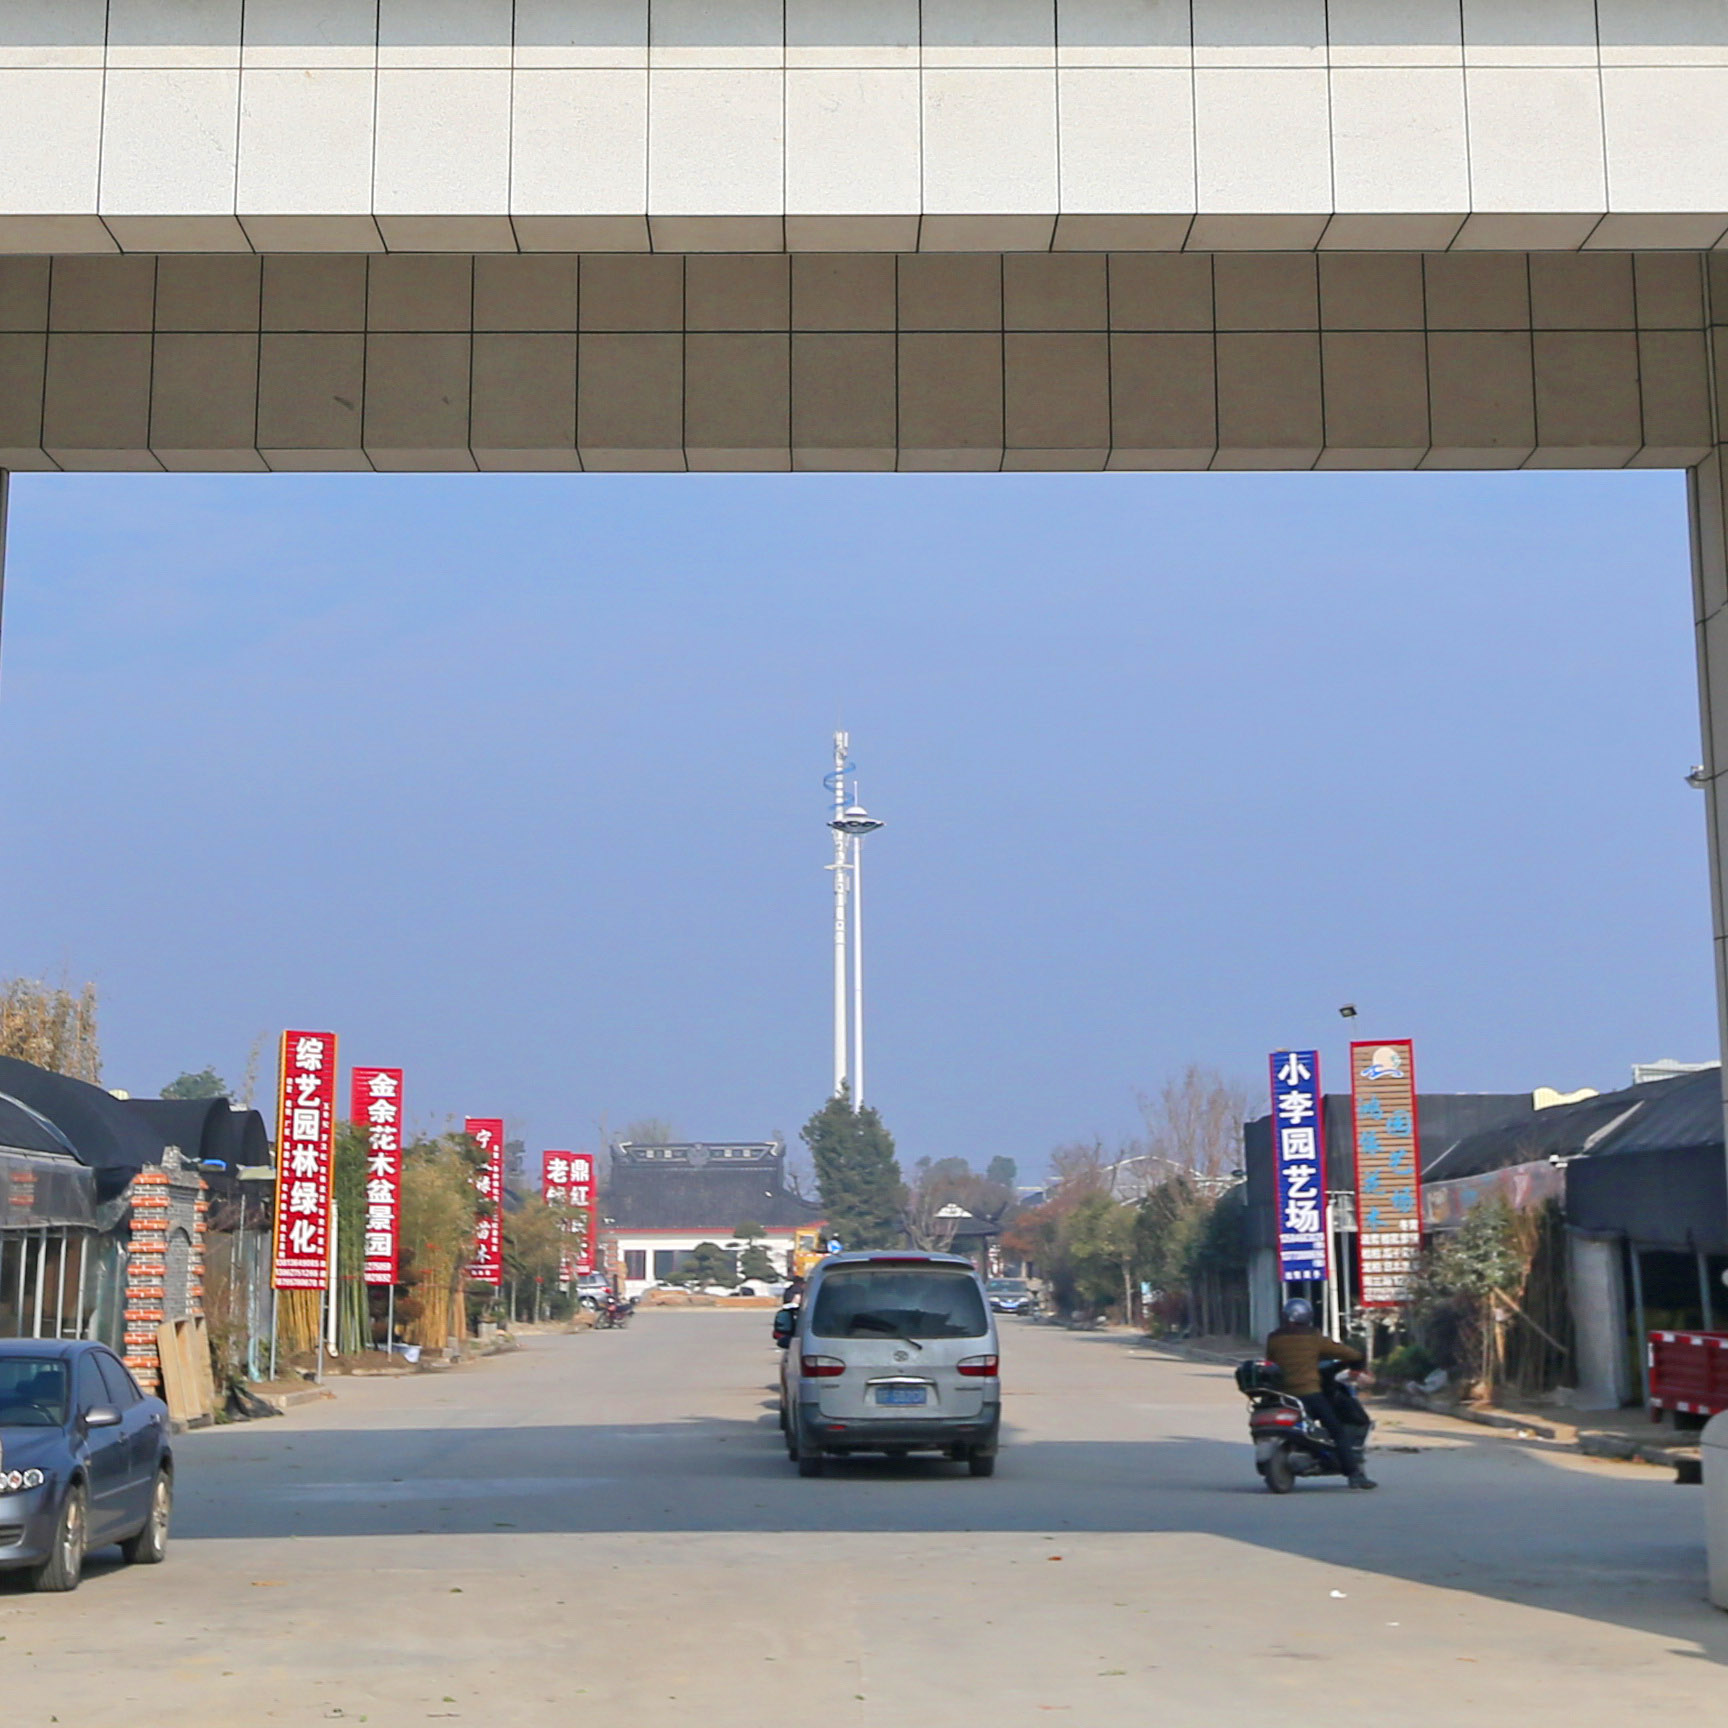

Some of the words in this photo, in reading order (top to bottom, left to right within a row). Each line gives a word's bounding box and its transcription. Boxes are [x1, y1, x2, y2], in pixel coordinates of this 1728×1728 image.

[289, 1037, 324, 1254] 综艺园林绿化
[364, 1072, 399, 1257] 金余花木盆景园
[1278, 1052, 1320, 1233] 小李园艺场
